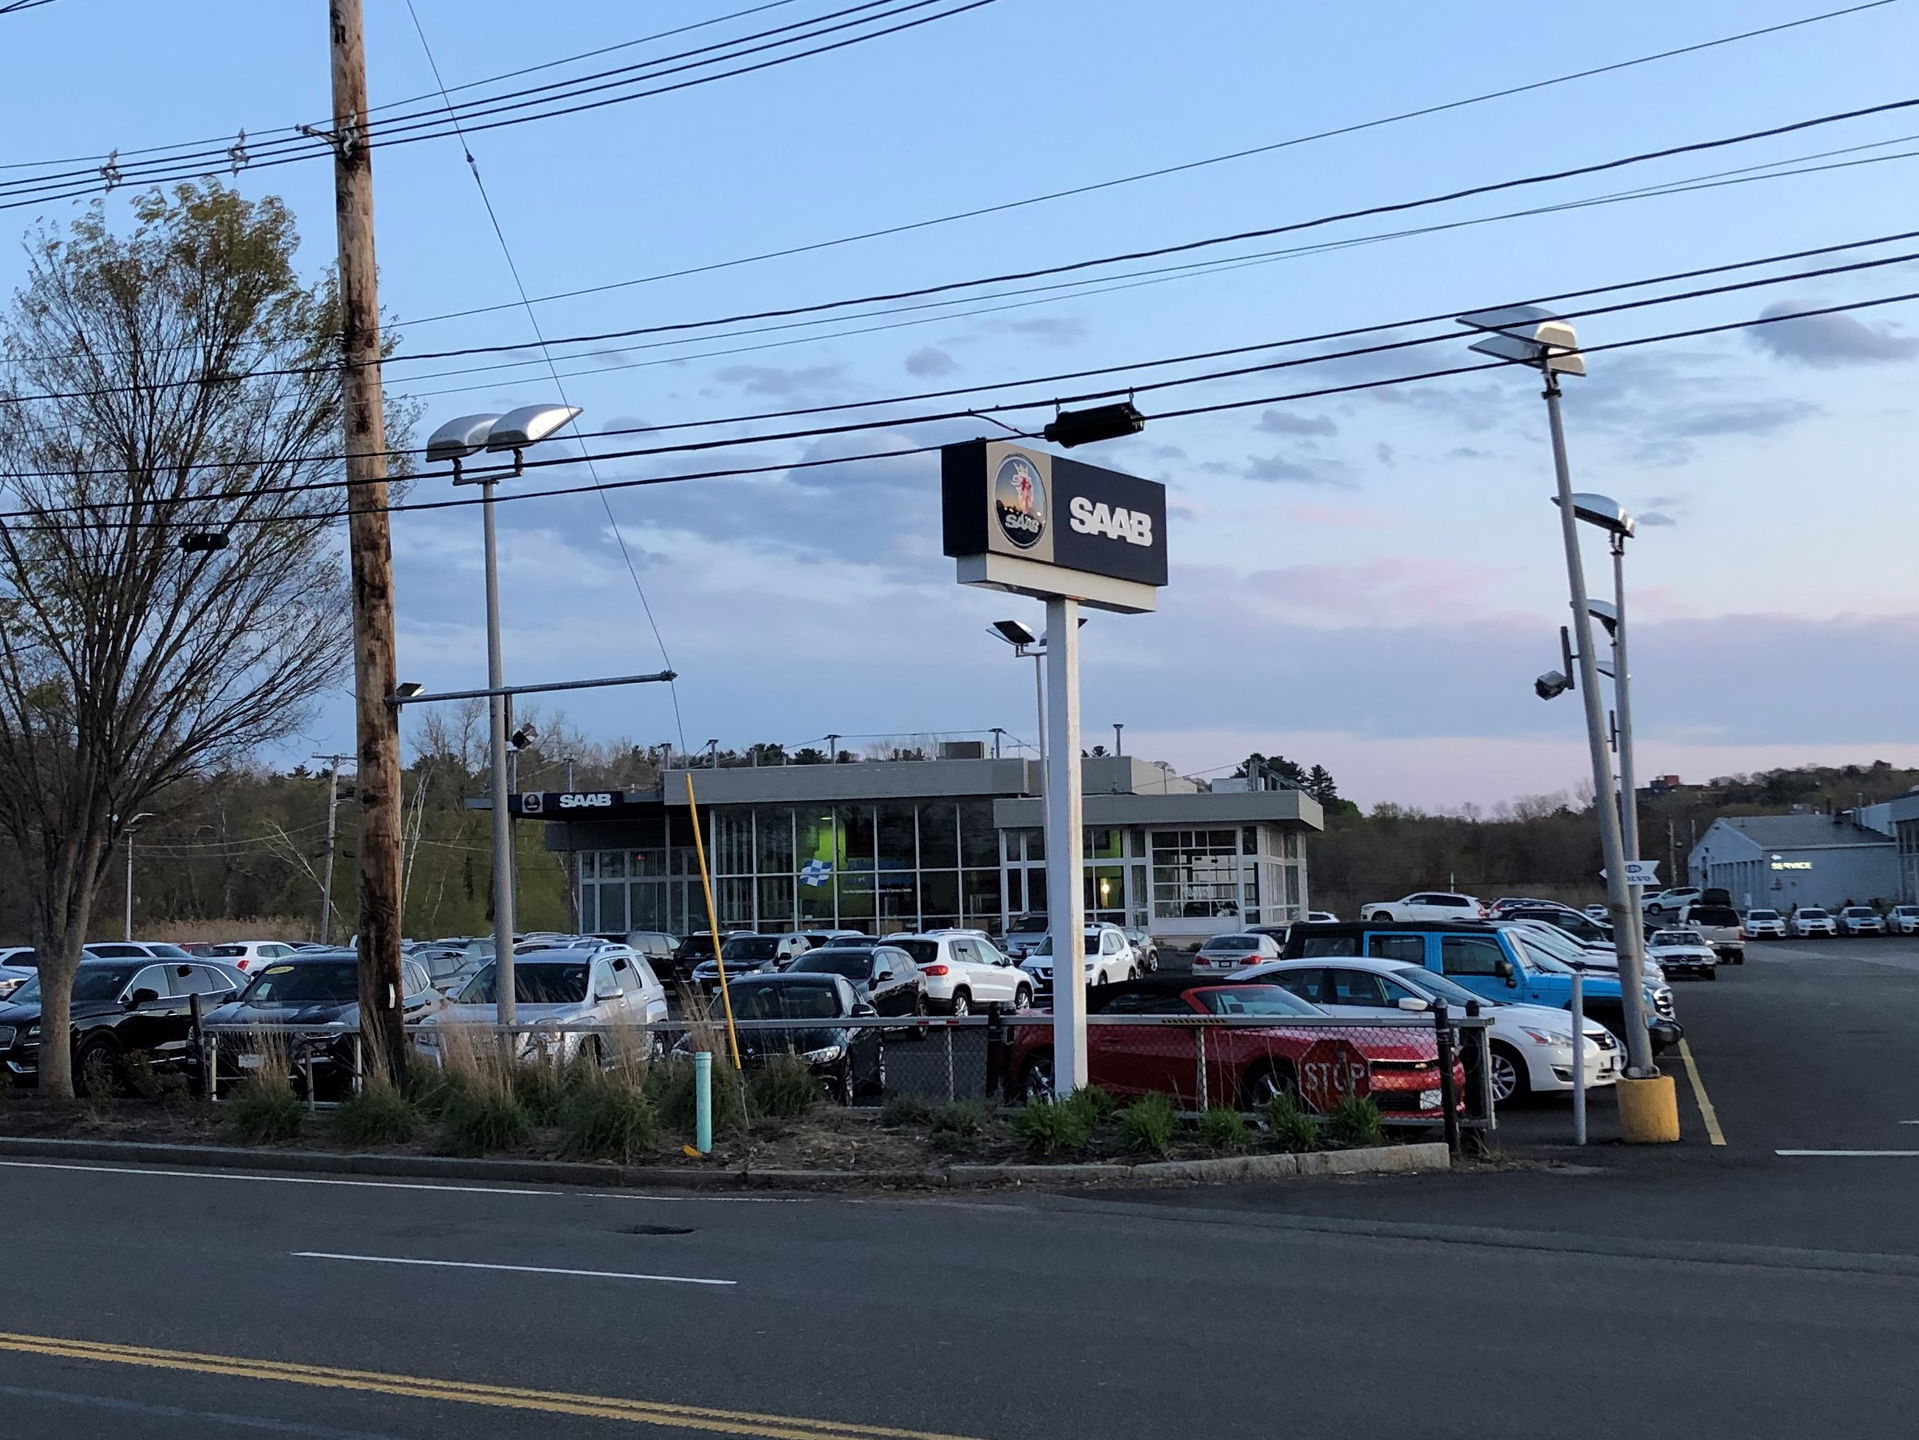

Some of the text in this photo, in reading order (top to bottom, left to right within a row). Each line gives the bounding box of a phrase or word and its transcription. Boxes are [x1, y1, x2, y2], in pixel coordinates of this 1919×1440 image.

[1005, 514, 1040, 533] SAAB
[1069, 496, 1153, 547] SAAB
[560, 793, 612, 808] SAAB
[1771, 861, 1813, 870] SERVICE
[1304, 1062, 1366, 1099] STOP
